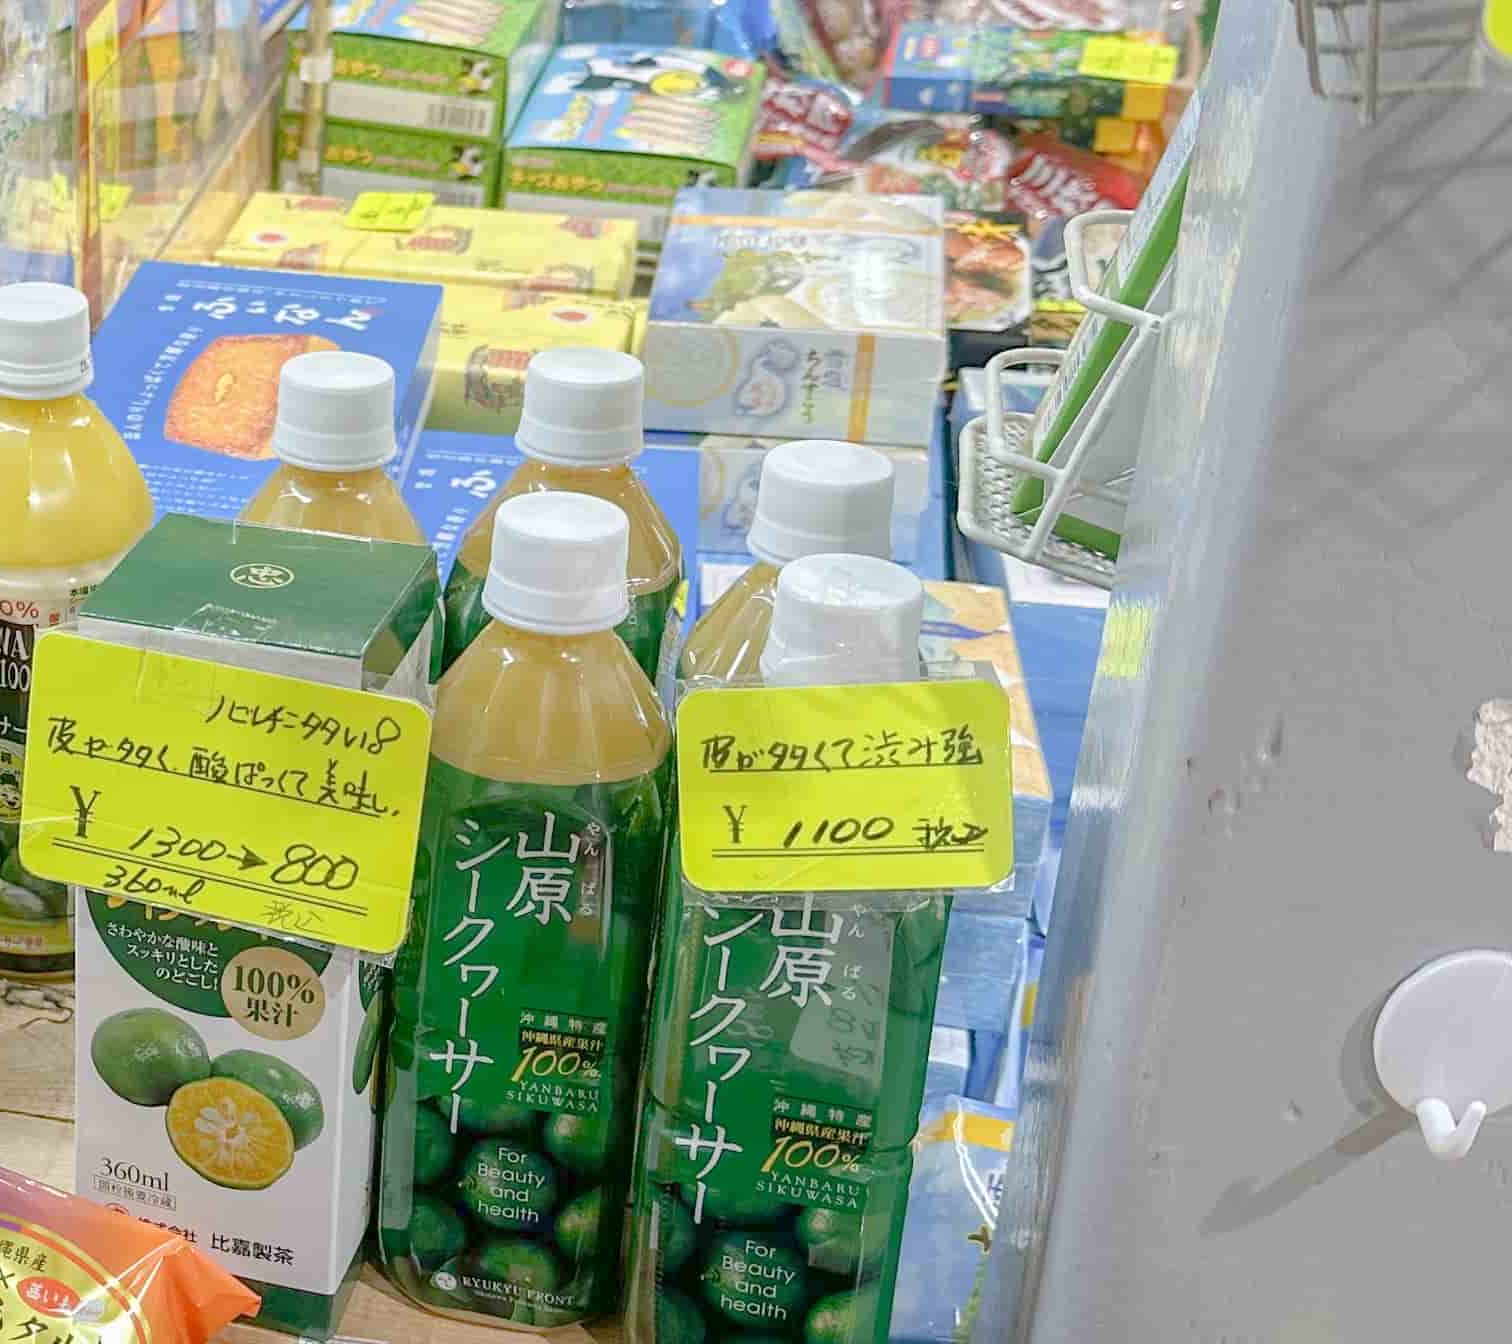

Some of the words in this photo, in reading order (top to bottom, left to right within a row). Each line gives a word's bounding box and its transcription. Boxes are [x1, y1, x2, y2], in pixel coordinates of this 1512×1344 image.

[68, 784, 102, 840] ¥
[128, 825, 227, 862] 1300
[270, 843, 360, 891] 800
[722, 805, 749, 845] ¥
[782, 813, 896, 850] 1100
[504, 811, 582, 927] 山原
[105, 919, 220, 957] さわやかな酸味と
[125, 940, 219, 975] スッキリとした
[231, 963, 317, 1006] 100%
[245, 998, 300, 1030] 果汁
[505, 1090, 599, 1113] SIKUWASA
[519, 1080, 599, 1102] YANBARU
[772, 1097, 874, 1128] 沖縄特産
[497, 1146, 528, 1164] For
[97, 1157, 172, 1194] 360ml
[476, 1165, 546, 1191] Beauty
[768, 1170, 861, 1198] YANBARU
[490, 1186, 530, 1203] and
[754, 1180, 859, 1210] SIKUWASA
[476, 1199, 540, 1225] health
[209, 1229, 297, 1267] 比嘉製茶
[743, 1239, 778, 1261] For
[461, 1272, 521, 1295] RYUKYU
[721, 1256, 797, 1285] Beauty
[735, 1281, 778, 1300] and
[721, 1294, 789, 1323] health
